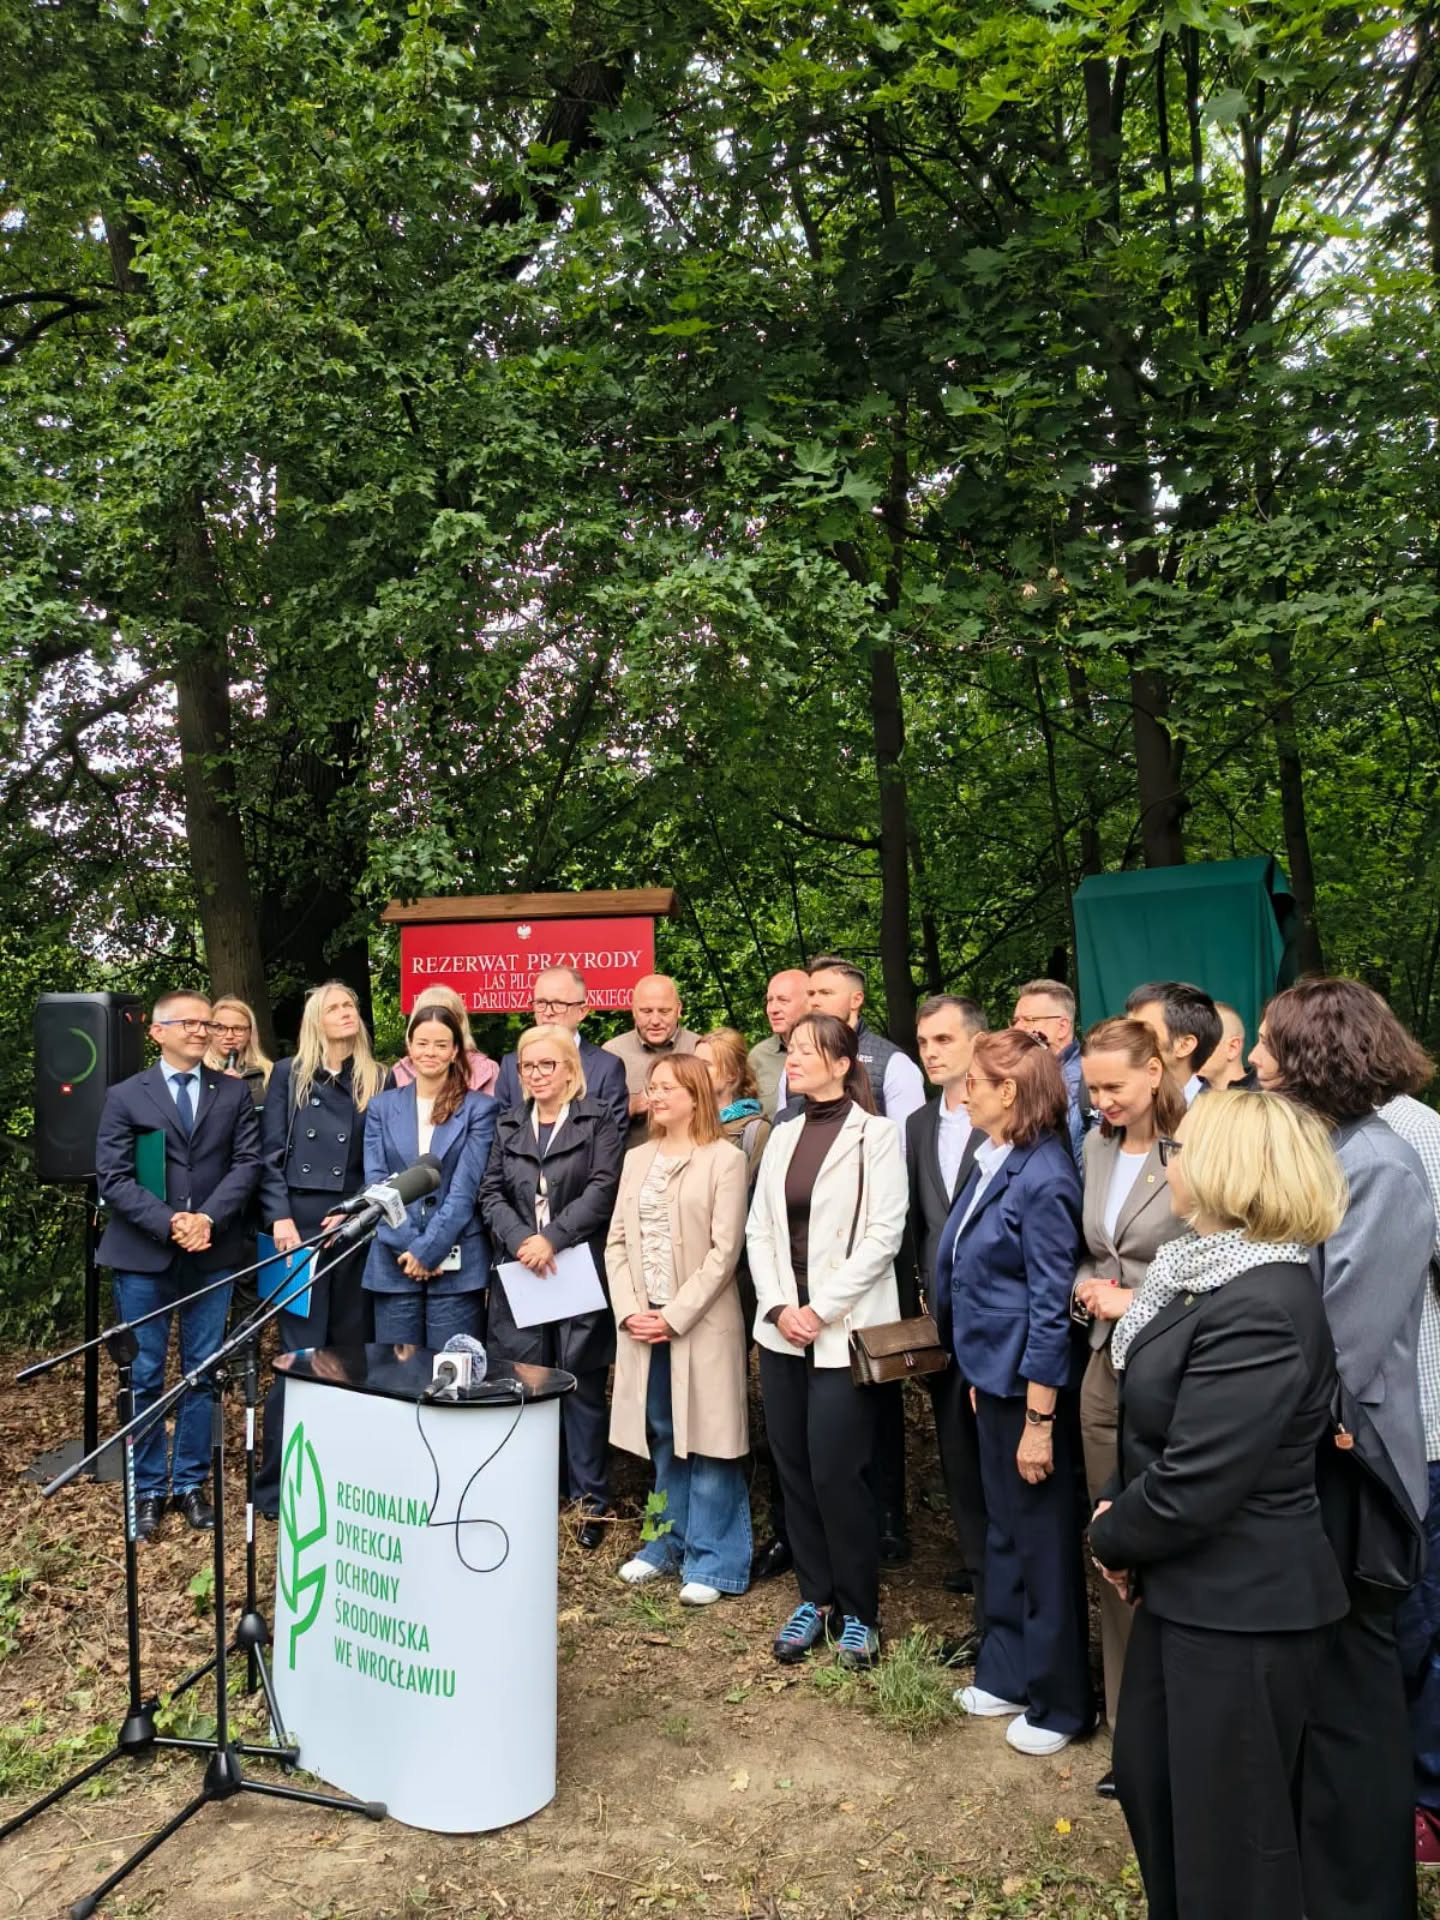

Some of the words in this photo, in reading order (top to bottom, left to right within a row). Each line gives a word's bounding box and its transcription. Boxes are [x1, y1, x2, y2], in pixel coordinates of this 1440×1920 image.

[411, 953, 519, 974] REZERWAT
[527, 950, 643, 970] PRZYRODY
[473, 991, 534, 1009] DARIUSZA
[335, 1480, 430, 1528] REGIONALNA
[335, 1519, 403, 1564] DYREKCJA
[334, 1558, 401, 1602] OCHRONY
[334, 1592, 431, 1654] ŚRODOWISKA
[333, 1639, 352, 1669] WE
[355, 1647, 457, 1698] WROCŁAWIU
